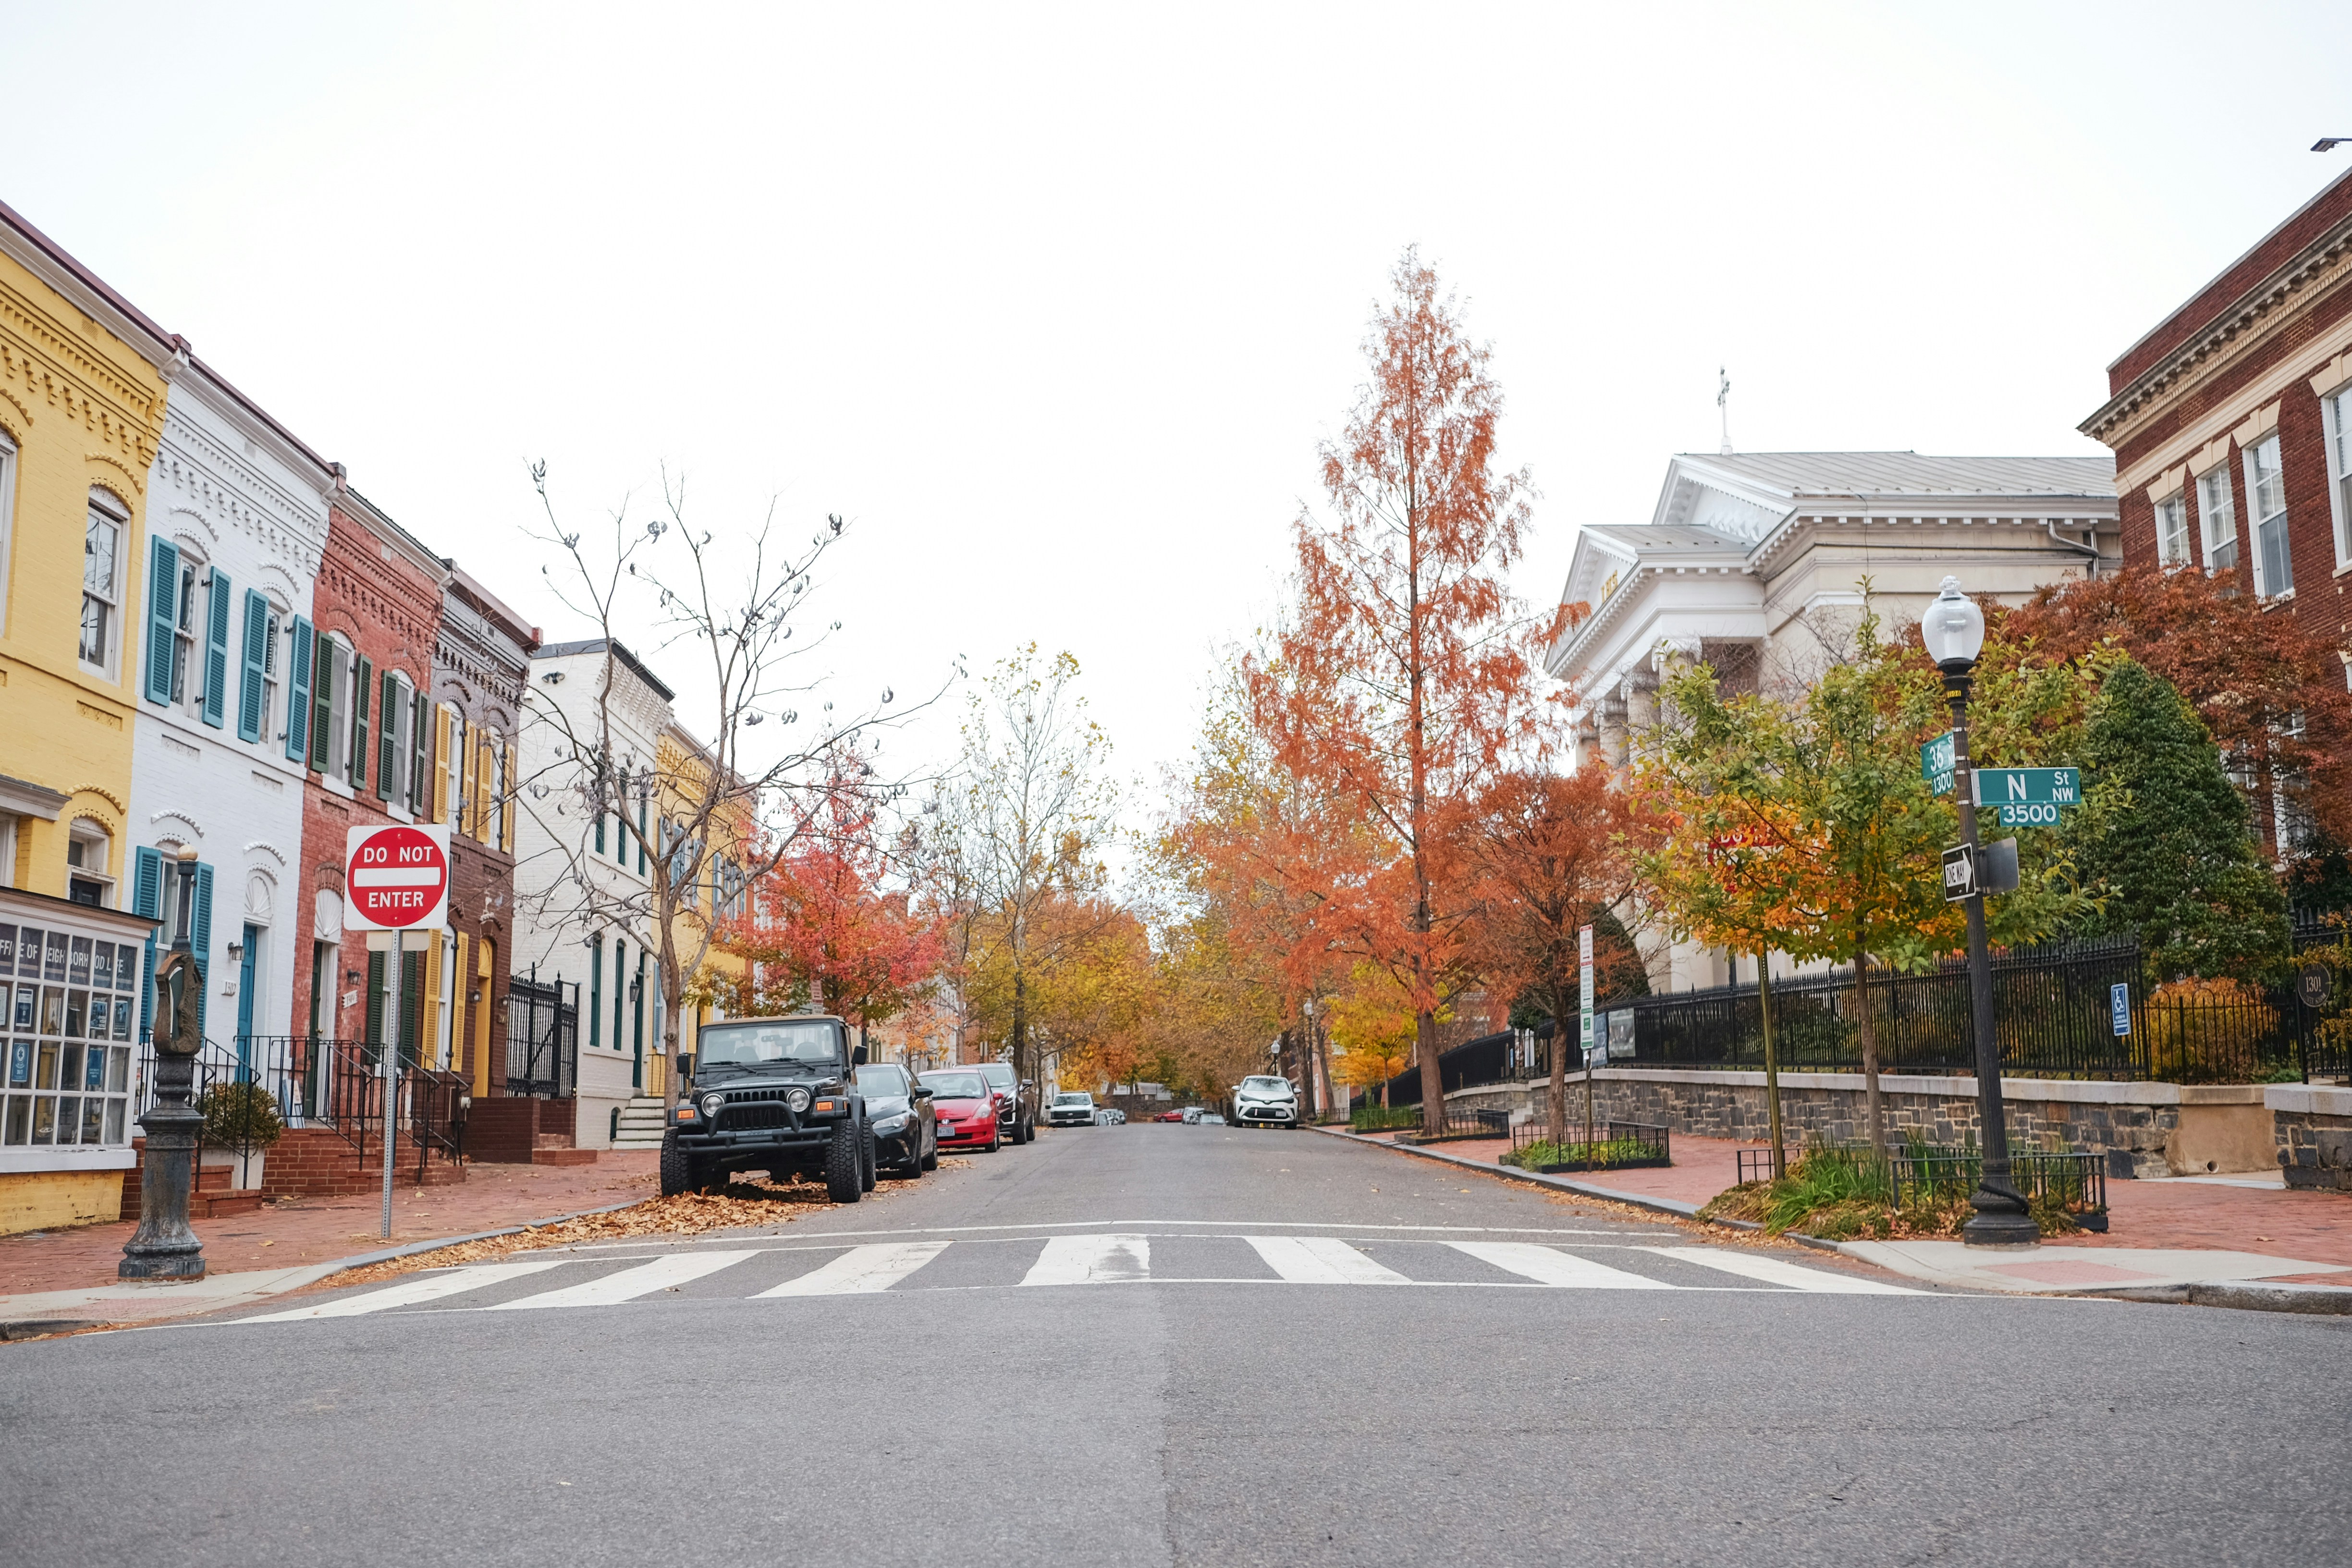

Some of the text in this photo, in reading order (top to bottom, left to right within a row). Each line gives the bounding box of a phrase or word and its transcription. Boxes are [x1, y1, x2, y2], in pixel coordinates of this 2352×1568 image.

[1929, 743, 1944, 772] 36
[1934, 771, 1951, 795] 1300
[2007, 771, 2069, 800] N St
[2052, 787, 2073, 801] NW
[2003, 805, 2056, 823] 3500
[364, 846, 433, 863] DO NOT
[1947, 862, 1965, 884] ONE WAY
[368, 891, 424, 907] ENTER
[0, 939, 24, 957] FFIE
[27, 943, 38, 959] OF
[46, 947, 105, 970] EIGHORHOD
[2306, 976, 2322, 992] 1301
